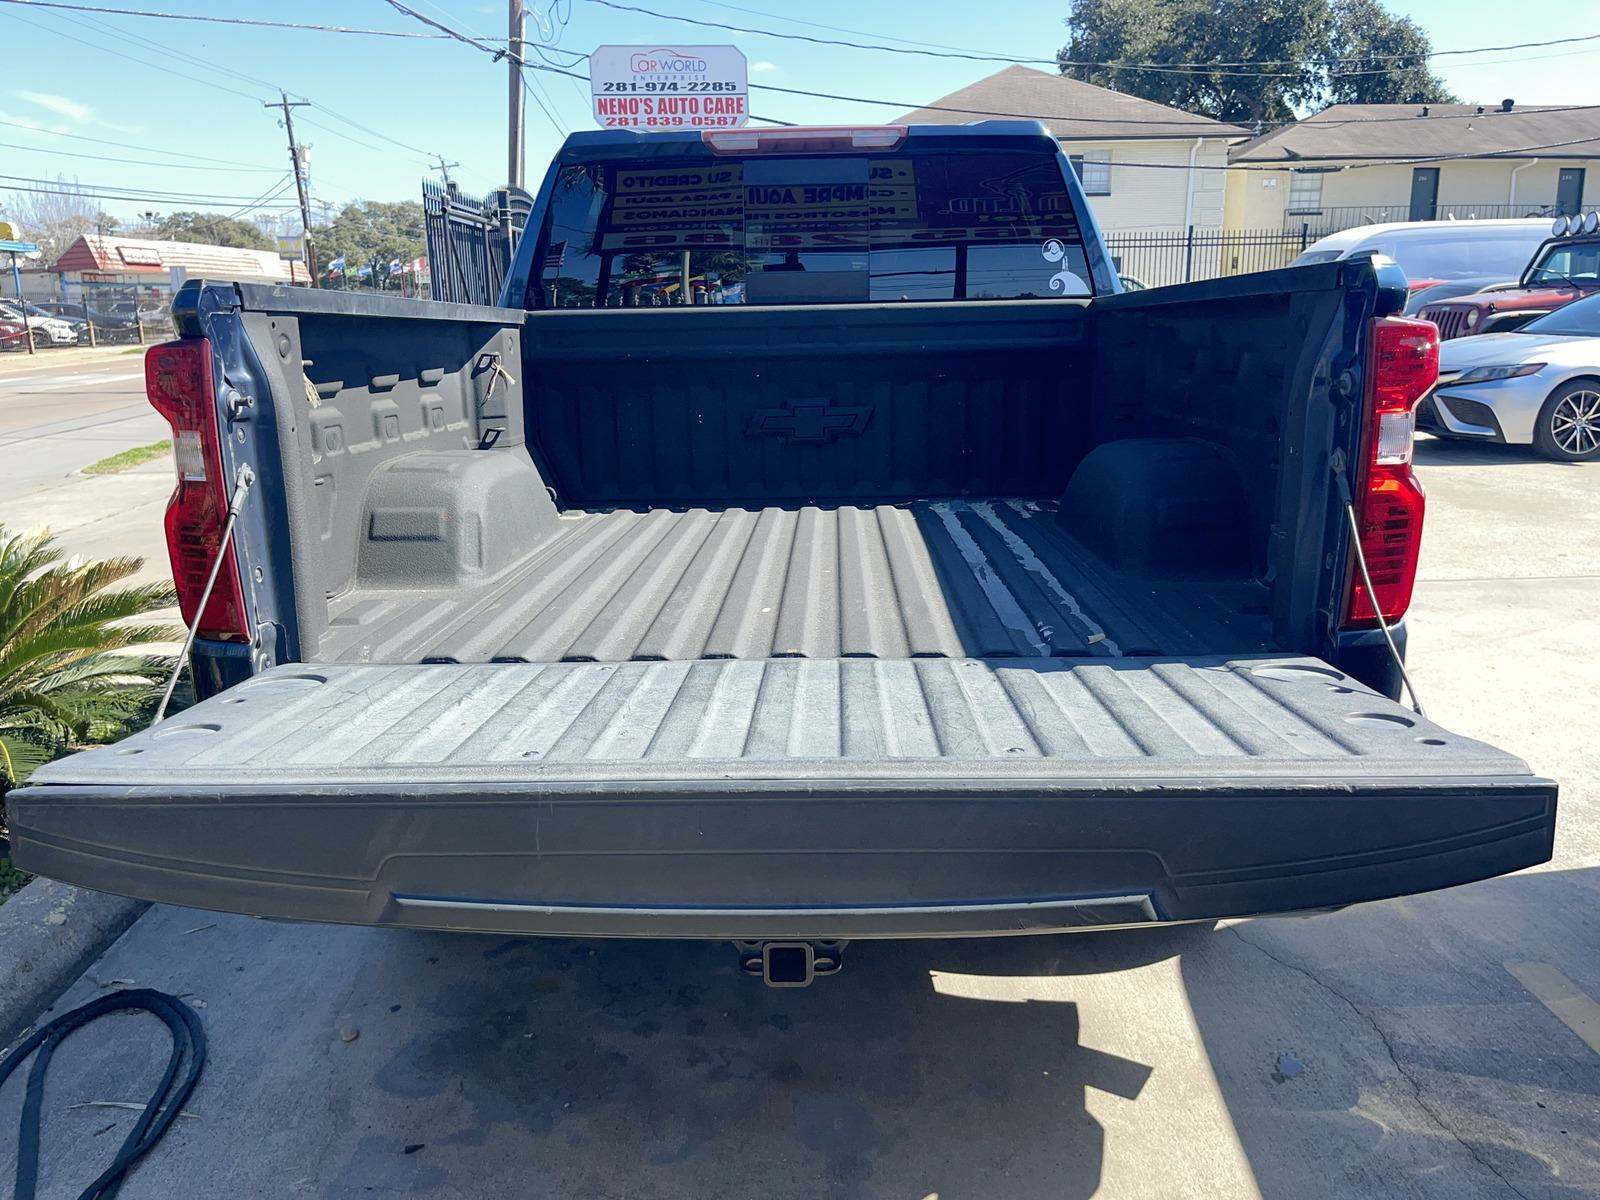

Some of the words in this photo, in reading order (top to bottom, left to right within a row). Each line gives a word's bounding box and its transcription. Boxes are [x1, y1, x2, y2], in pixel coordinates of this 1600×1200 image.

[658, 59, 707, 72] WORLD
[603, 81, 737, 92] 281-974-2285
[598, 97, 654, 115] NENO'S
[657, 97, 699, 115] AUTO
[703, 96, 744, 115] CARE
[606, 116, 738, 127] 281-839-0587
